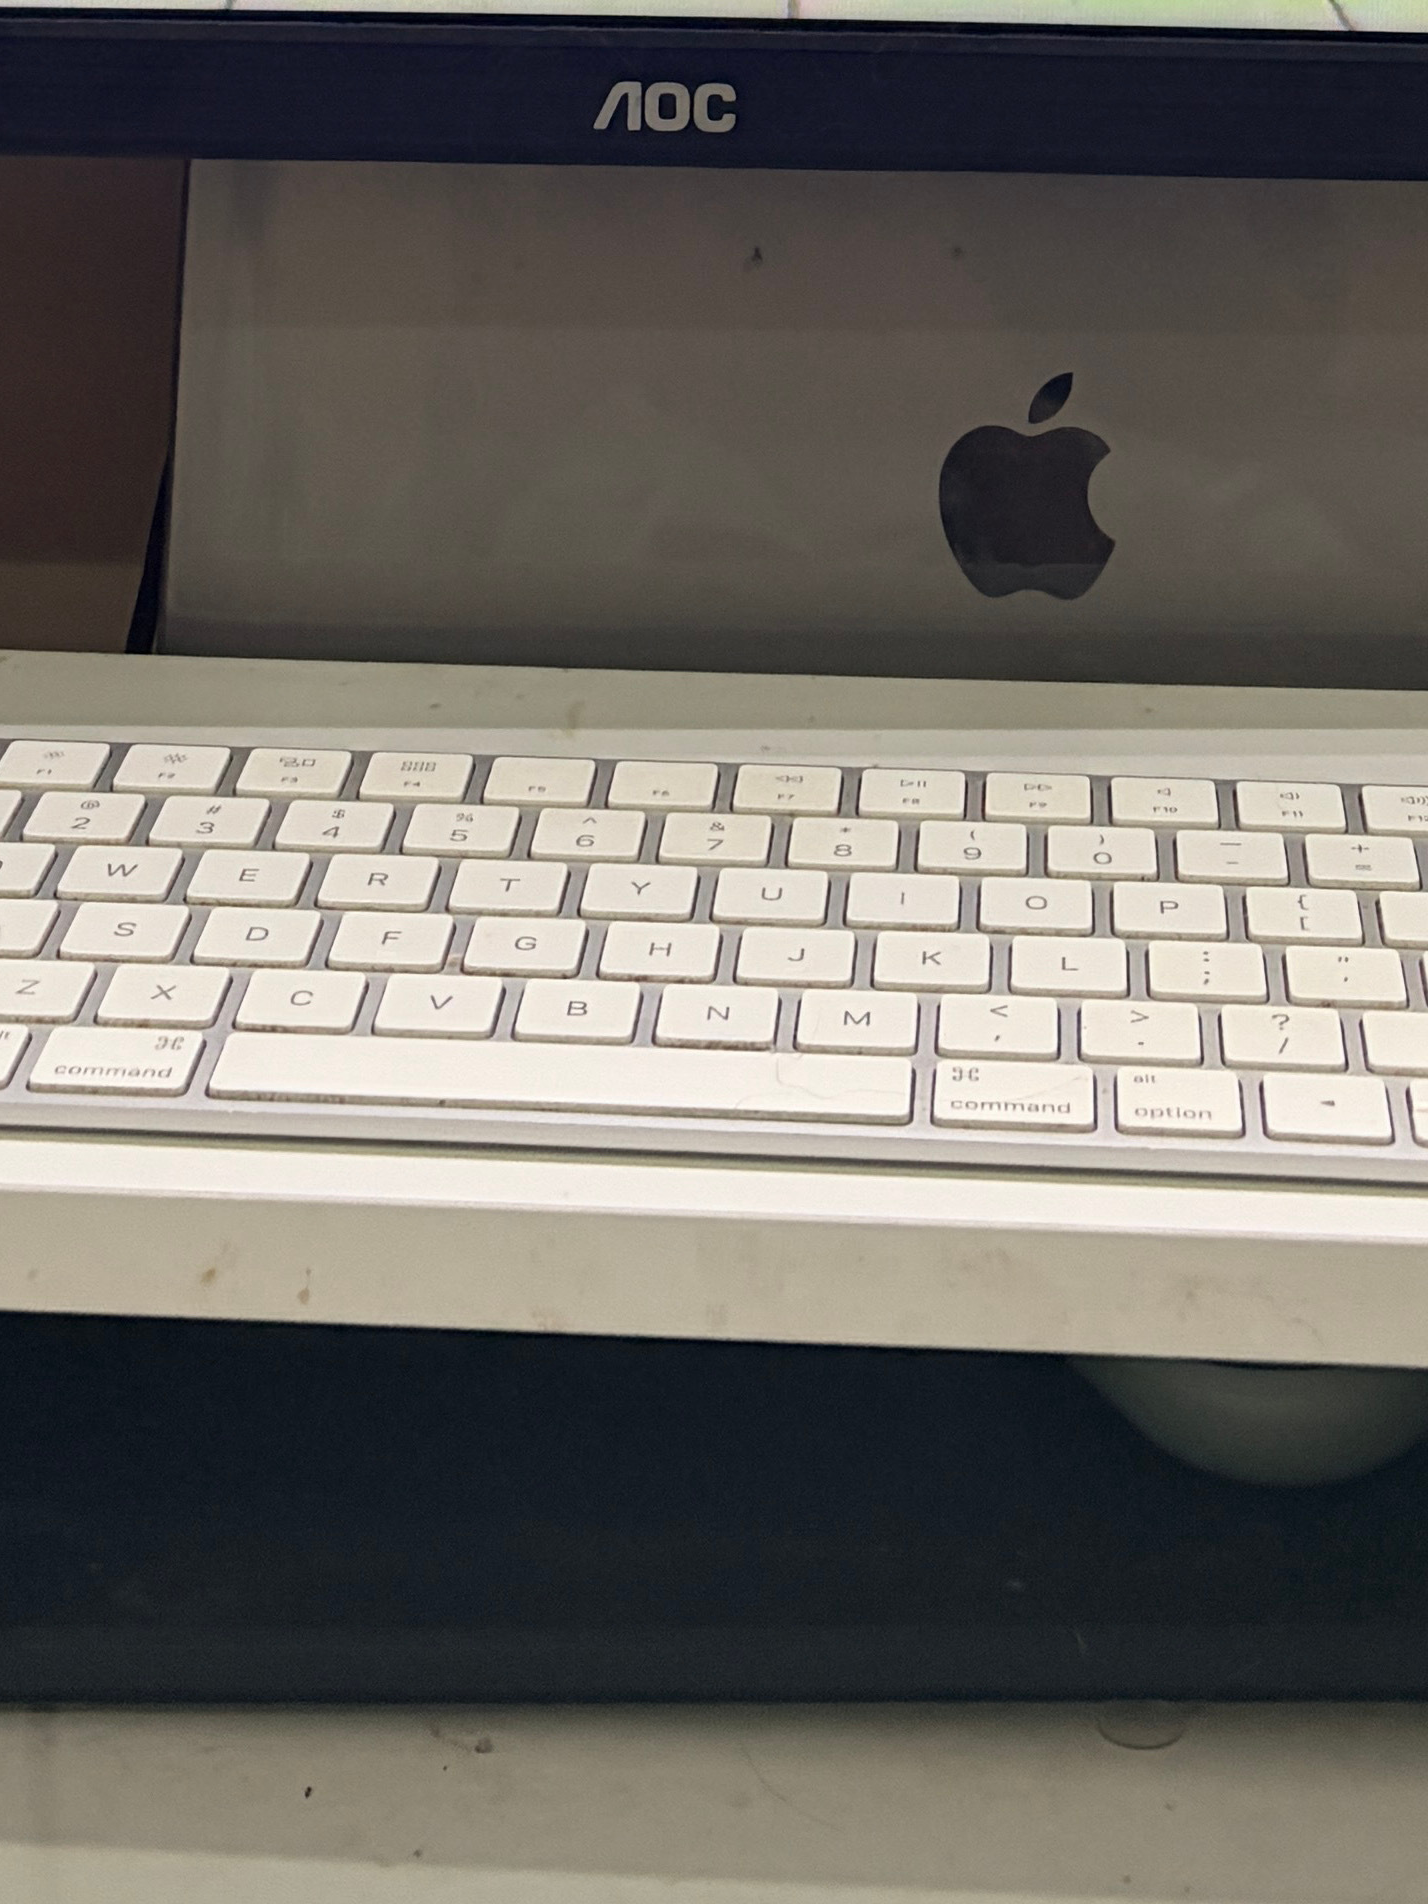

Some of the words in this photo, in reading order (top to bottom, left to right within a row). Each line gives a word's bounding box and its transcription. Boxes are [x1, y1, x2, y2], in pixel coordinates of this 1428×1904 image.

[592, 81, 737, 133] AOC
[70, 816, 91, 830] 2
[195, 821, 215, 835] 3
[321, 825, 340, 839] 4
[449, 829, 468, 842] 5
[575, 834, 595, 848] 6
[707, 838, 724, 851] 7
[833, 843, 853, 858] 8
[963, 847, 983, 860] 9
[107, 863, 139, 878] W
[238, 868, 260, 883] E
[367, 872, 389, 886] R
[499, 878, 521, 893] T
[631, 881, 652, 896] Y
[761, 886, 783, 902] U
[1025, 895, 1048, 911] O
[1159, 900, 1179, 915] P
[113, 921, 137, 937] S
[245, 926, 270, 942] D
[381, 930, 402, 946] F
[514, 936, 537, 951] G
[648, 942, 673, 957] H
[787, 947, 806, 962] J
[921, 950, 942, 966] K
[1061, 956, 1079, 972] L
[15, 979, 41, 996] Z
[150, 984, 177, 1001] X
[290, 990, 314, 1007] C
[430, 994, 454, 1010] V
[566, 1000, 588, 1017] B
[706, 1005, 730, 1021] N
[843, 1010, 871, 1027] M
[54, 1065, 173, 1079] command
[950, 1100, 1071, 1114] command
[1134, 1106, 1212, 1120] option
